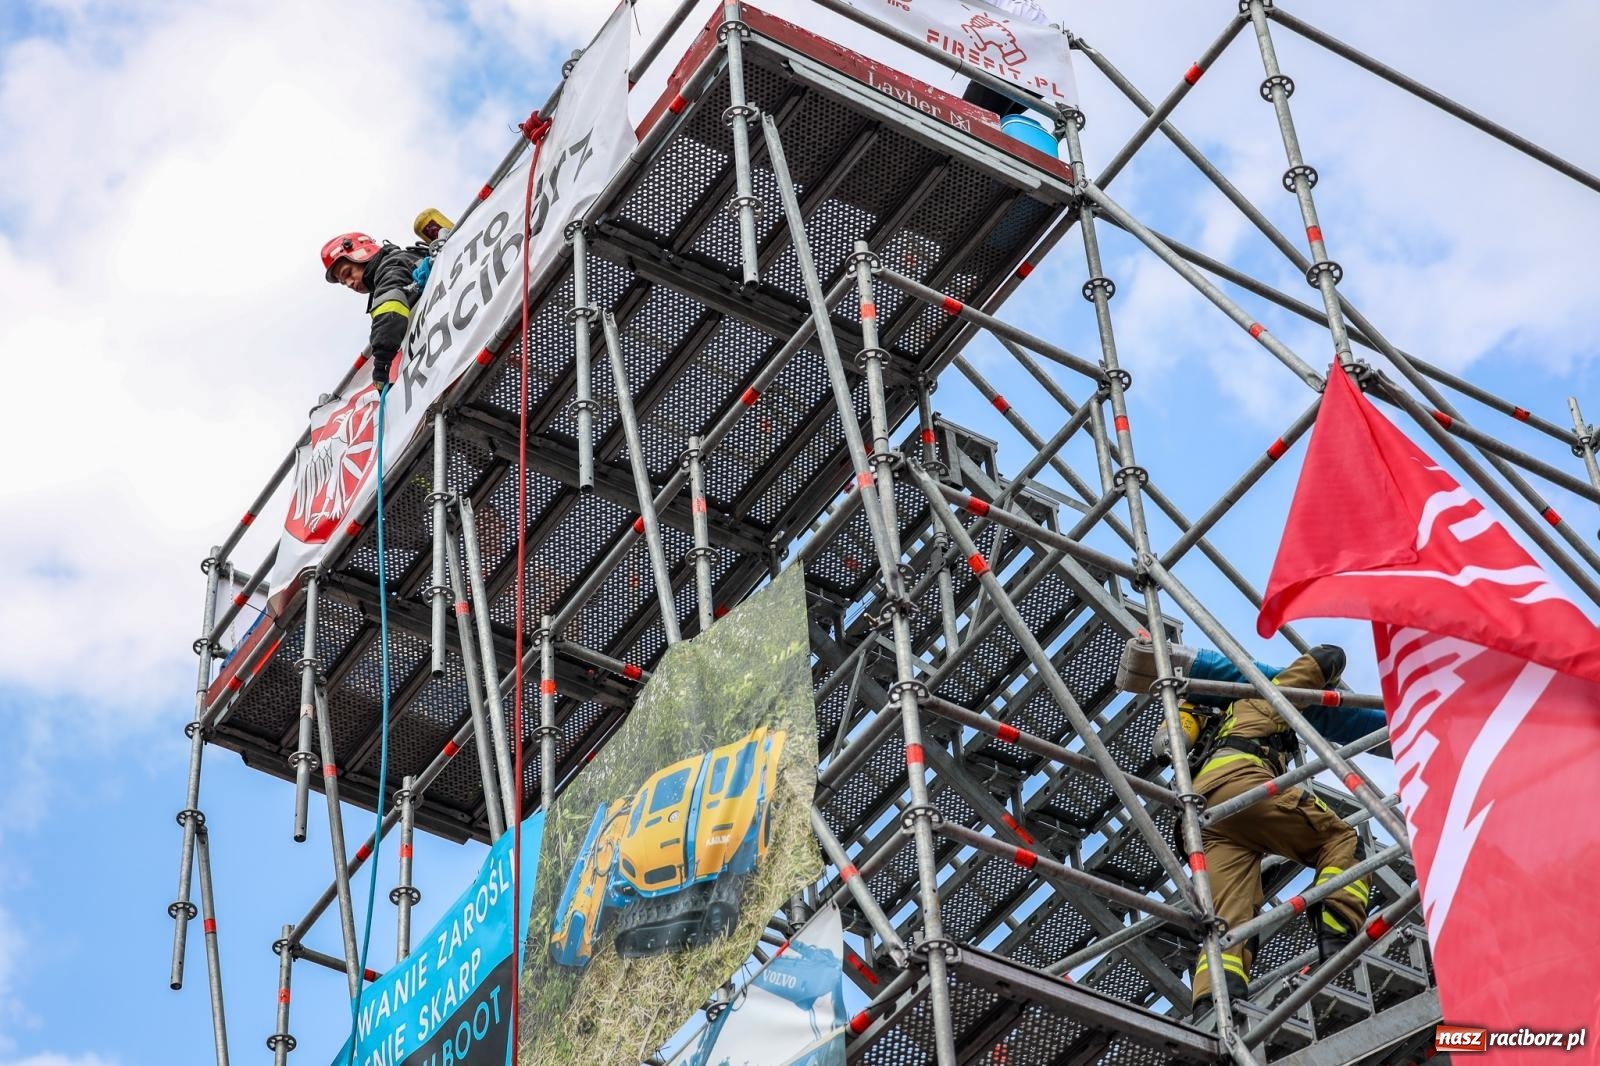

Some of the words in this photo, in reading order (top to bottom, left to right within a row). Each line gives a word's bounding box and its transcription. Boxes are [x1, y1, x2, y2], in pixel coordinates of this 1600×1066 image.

[867, 71, 942, 119] Layher
[926, 28, 1065, 99] FIREFIT.PL
[408, 211, 509, 360] MIASTO
[353, 951, 429, 1061] WANIE
[418, 947, 481, 1041] SKARP
[763, 969, 797, 989] VOLVO
